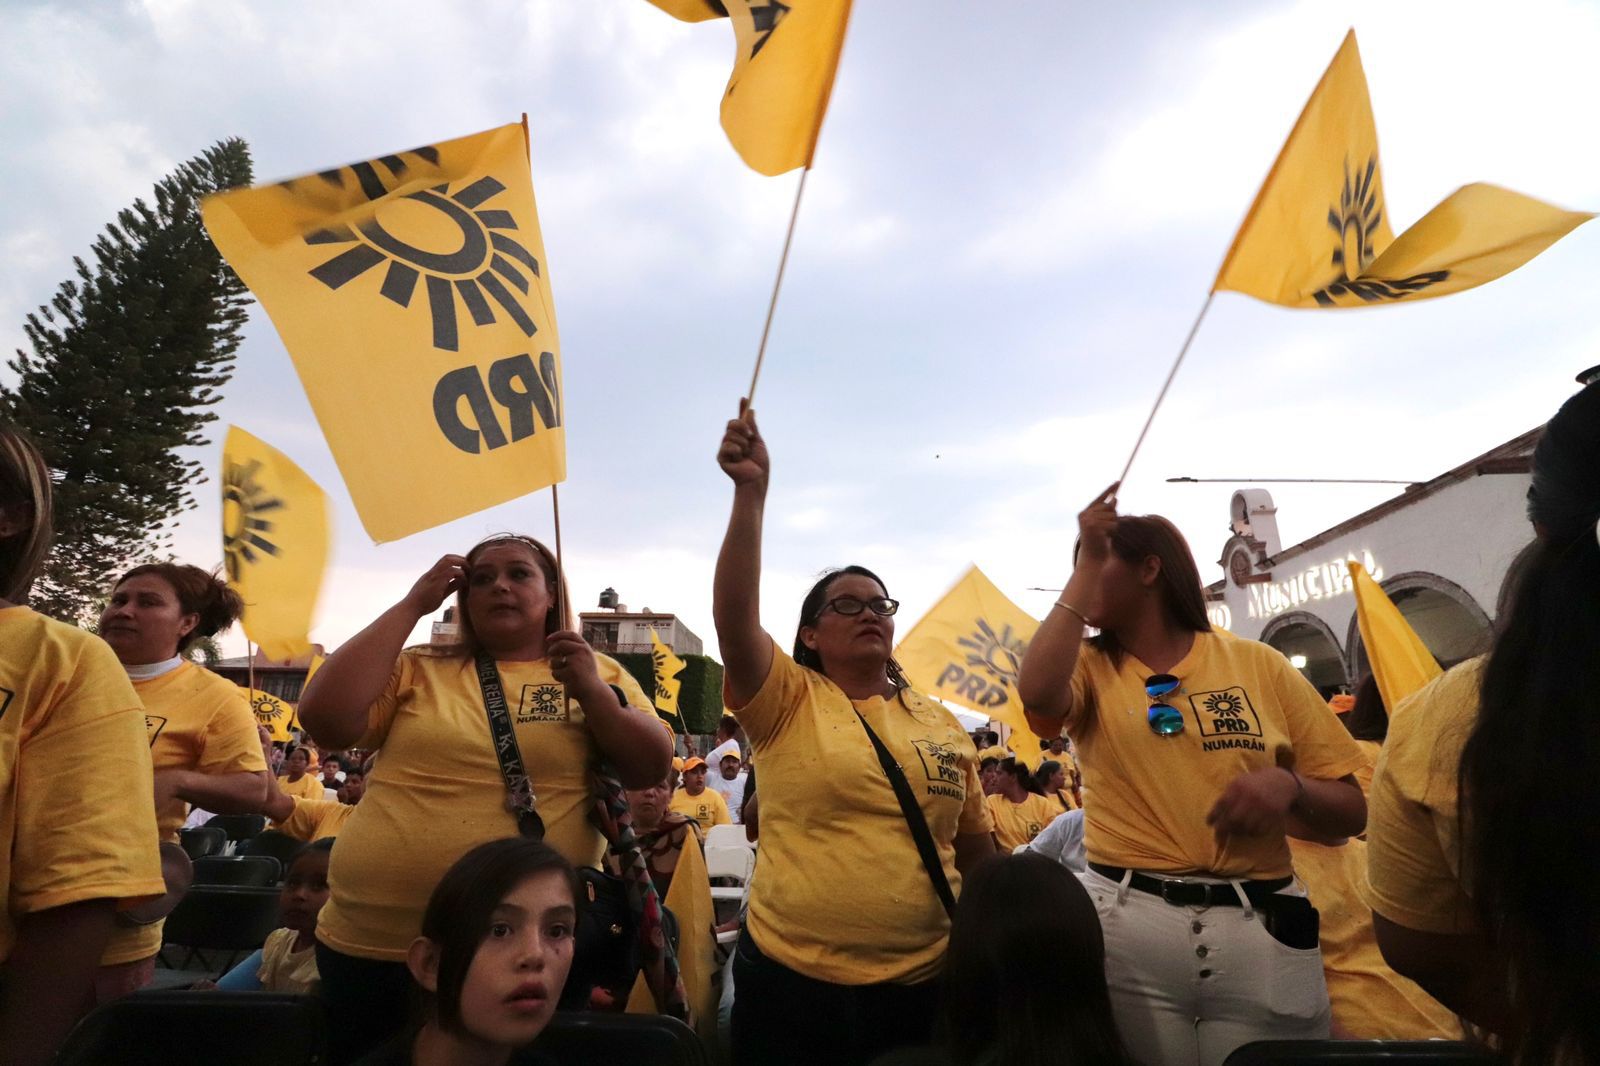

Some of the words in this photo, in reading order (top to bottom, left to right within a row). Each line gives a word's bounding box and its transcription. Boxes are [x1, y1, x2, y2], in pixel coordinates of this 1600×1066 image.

[936, 662, 1008, 707] PRD
[531, 704, 558, 715] PRD
[1213, 718, 1250, 733] PRD
[1203, 738, 1265, 752] NUMARÁN
[937, 765, 960, 783] PRD
